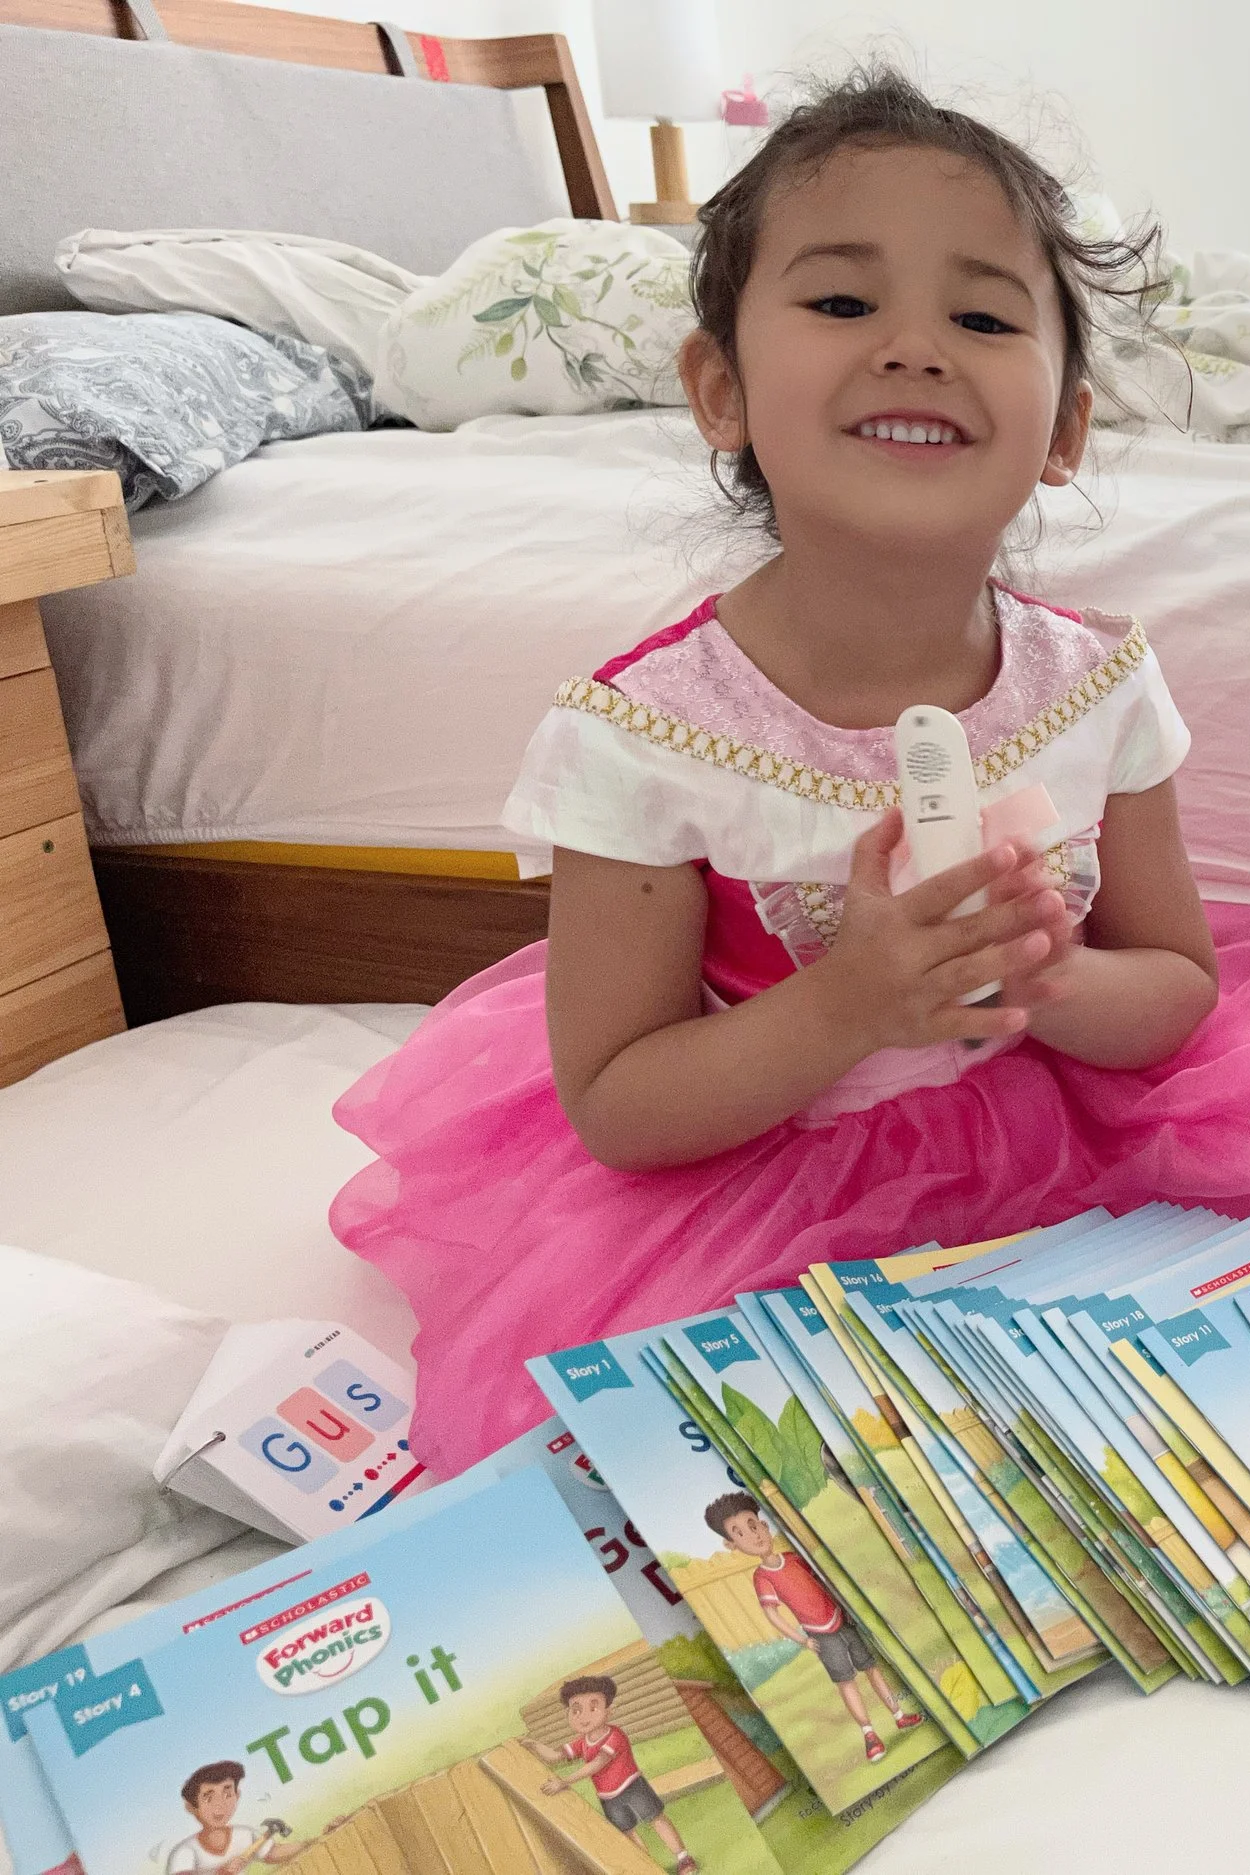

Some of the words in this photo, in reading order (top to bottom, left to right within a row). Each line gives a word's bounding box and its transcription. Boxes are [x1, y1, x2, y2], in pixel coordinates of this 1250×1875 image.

[840, 1274, 869, 1286] Story
[870, 1273, 884, 1283] 16
[799, 1306, 818, 1317] Sto
[1102, 1315, 1130, 1332] Story
[1130, 1310, 1145, 1321] 18
[701, 1336, 730, 1353] Story
[729, 1333, 740, 1345] 5
[1171, 1331, 1200, 1348] Story
[1199, 1324, 1213, 1336] 11
[566, 1363, 601, 1381] Story
[262, 1384, 381, 1472] Gus
[259, 1574, 368, 1635] SCHOLASTIC
[263, 1602, 374, 1669] Forward
[274, 1624, 383, 1687] Phonics
[8, 1682, 59, 1711] Story
[65, 1667, 87, 1687] 19
[73, 1692, 123, 1724] Story
[129, 1683, 142, 1697] 4
[246, 1697, 391, 1784] Tap
[406, 1645, 463, 1705] it
